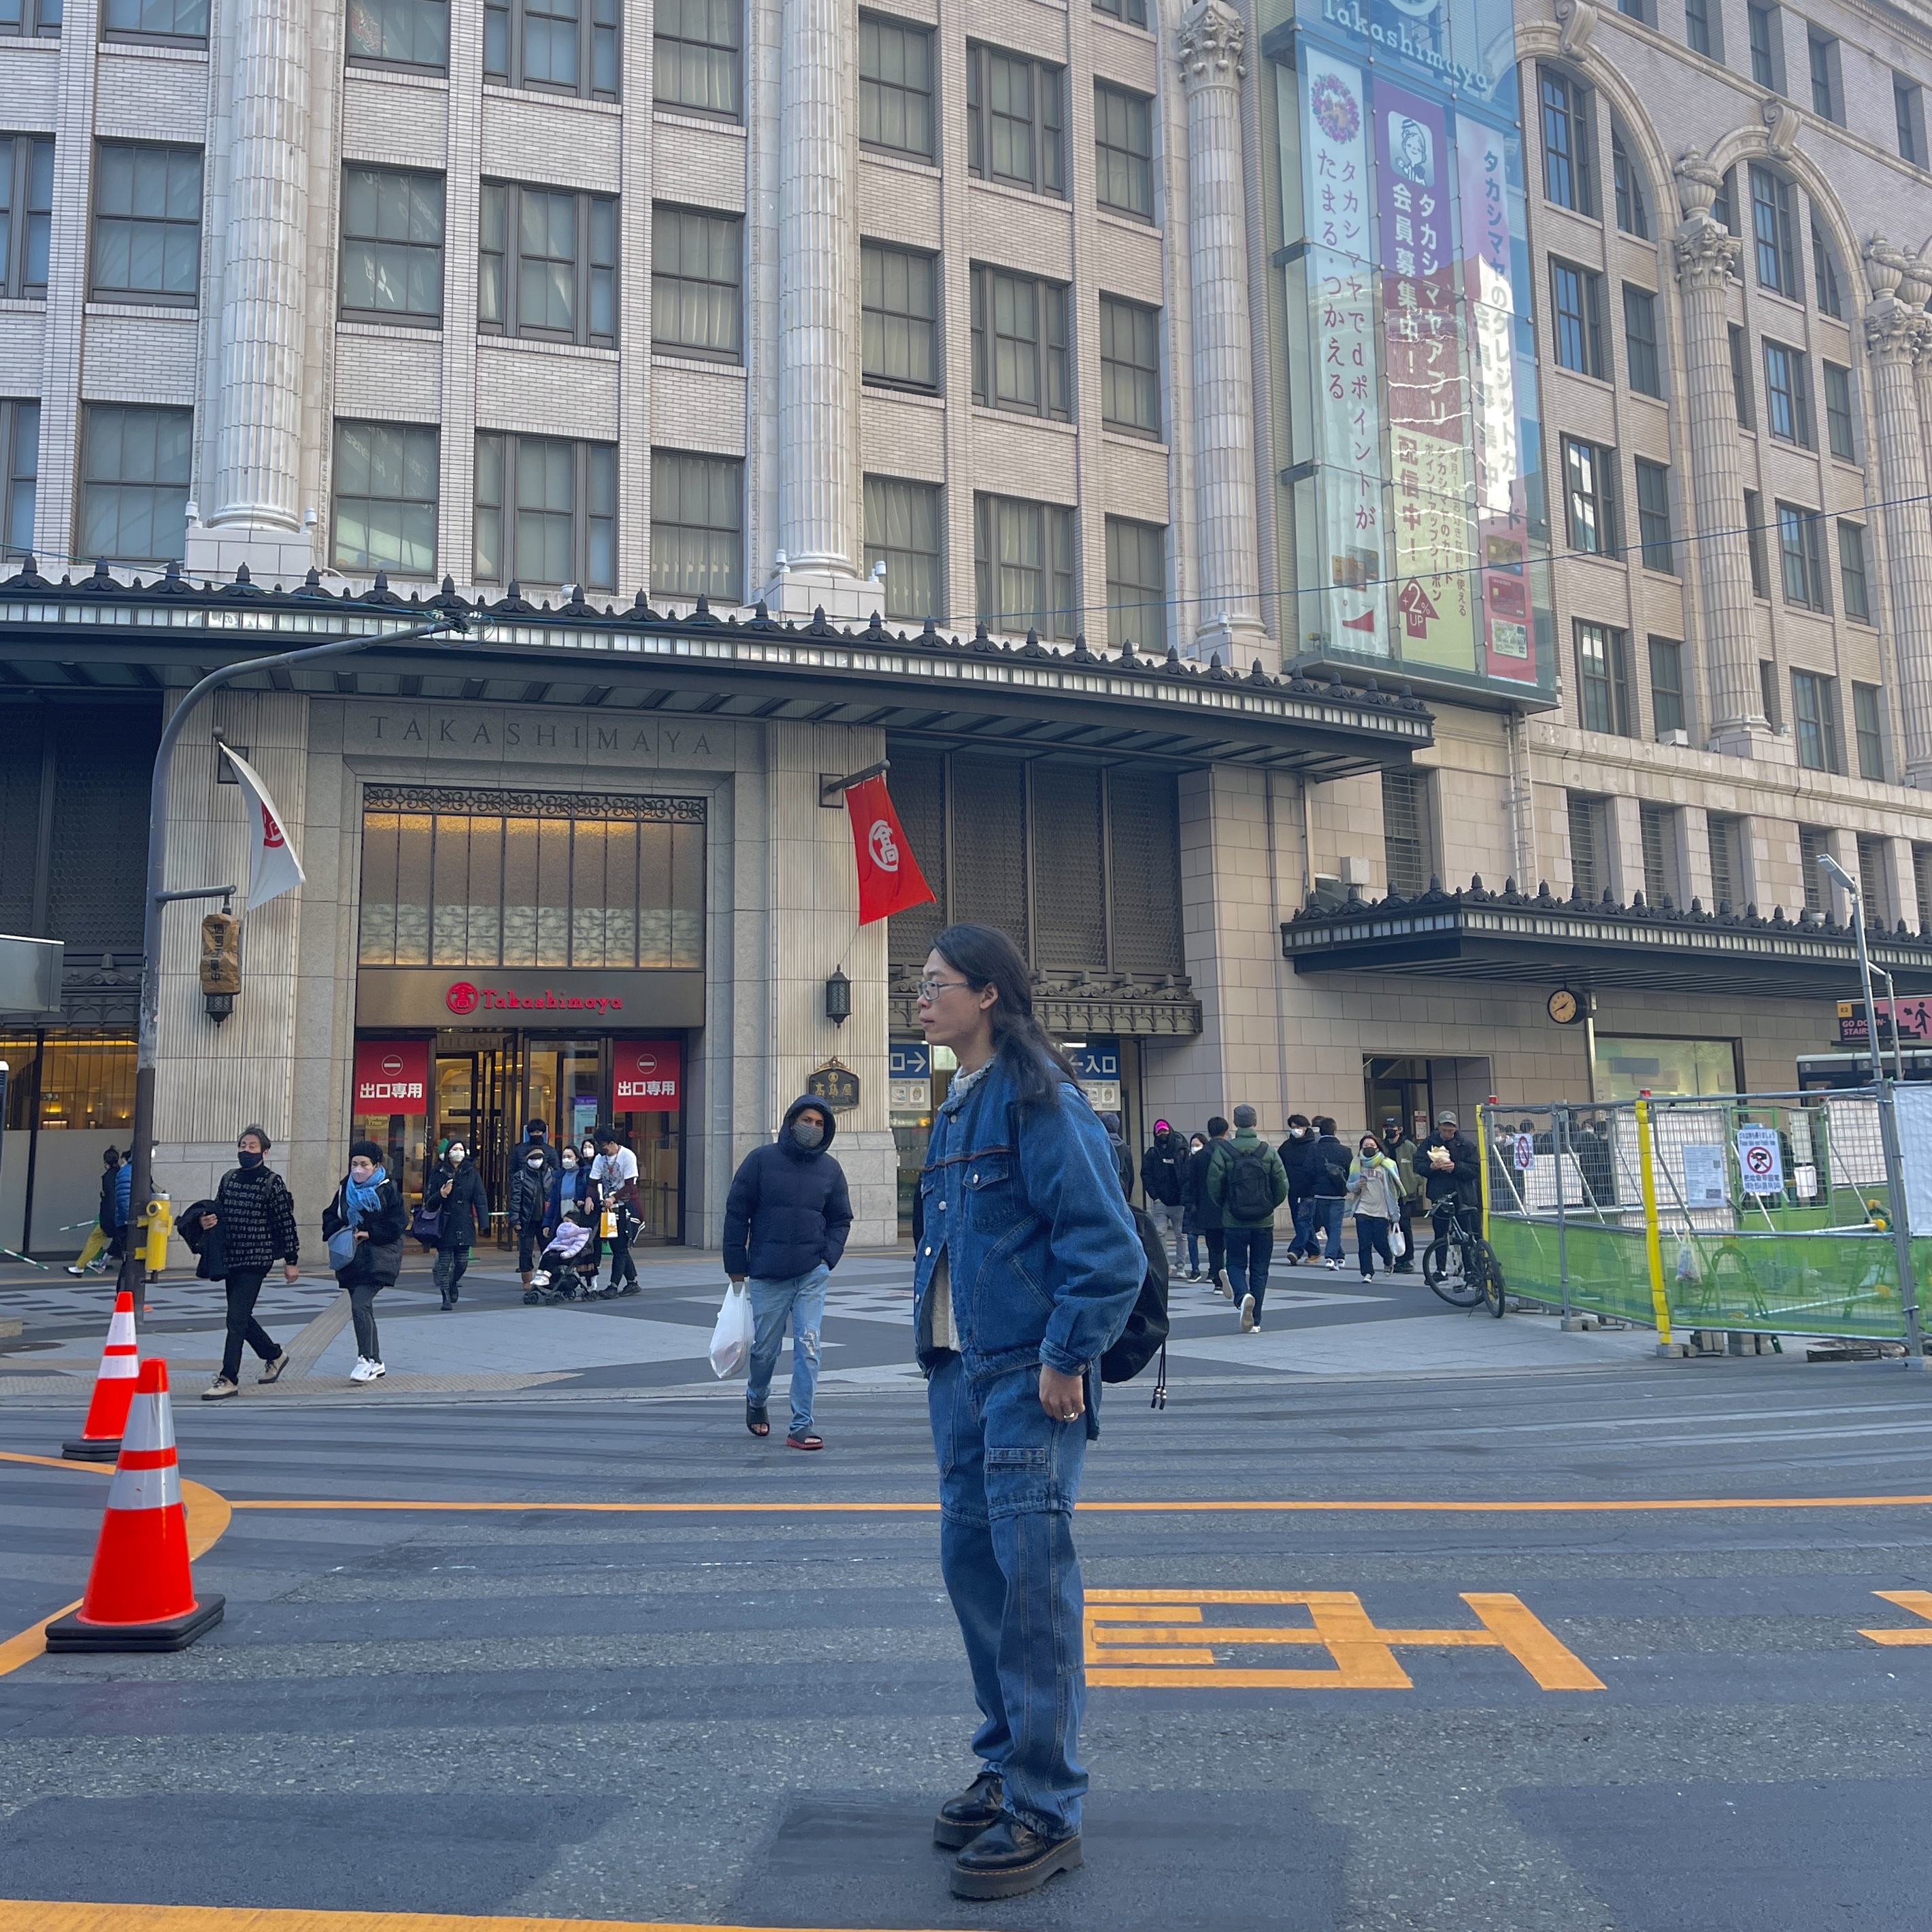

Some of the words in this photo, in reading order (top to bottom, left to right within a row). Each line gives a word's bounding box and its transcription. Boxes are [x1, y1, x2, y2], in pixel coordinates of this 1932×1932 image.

[1322, 0, 1490, 93] Takashimaya
[1418, 194, 1446, 425] タカシマヤアプリ
[1409, 614, 1424, 627] UP
[369, 716, 712, 755] TAKASHIMAYA
[480, 988, 622, 1014] Takashimaya
[1842, 1020, 1855, 1028] GO
[1856, 1018, 1887, 1027] DON-
[1085, 1054, 1117, 1073] 入口
[359, 1082, 423, 1099] 出口専用
[617, 1080, 676, 1097] 出口専用
